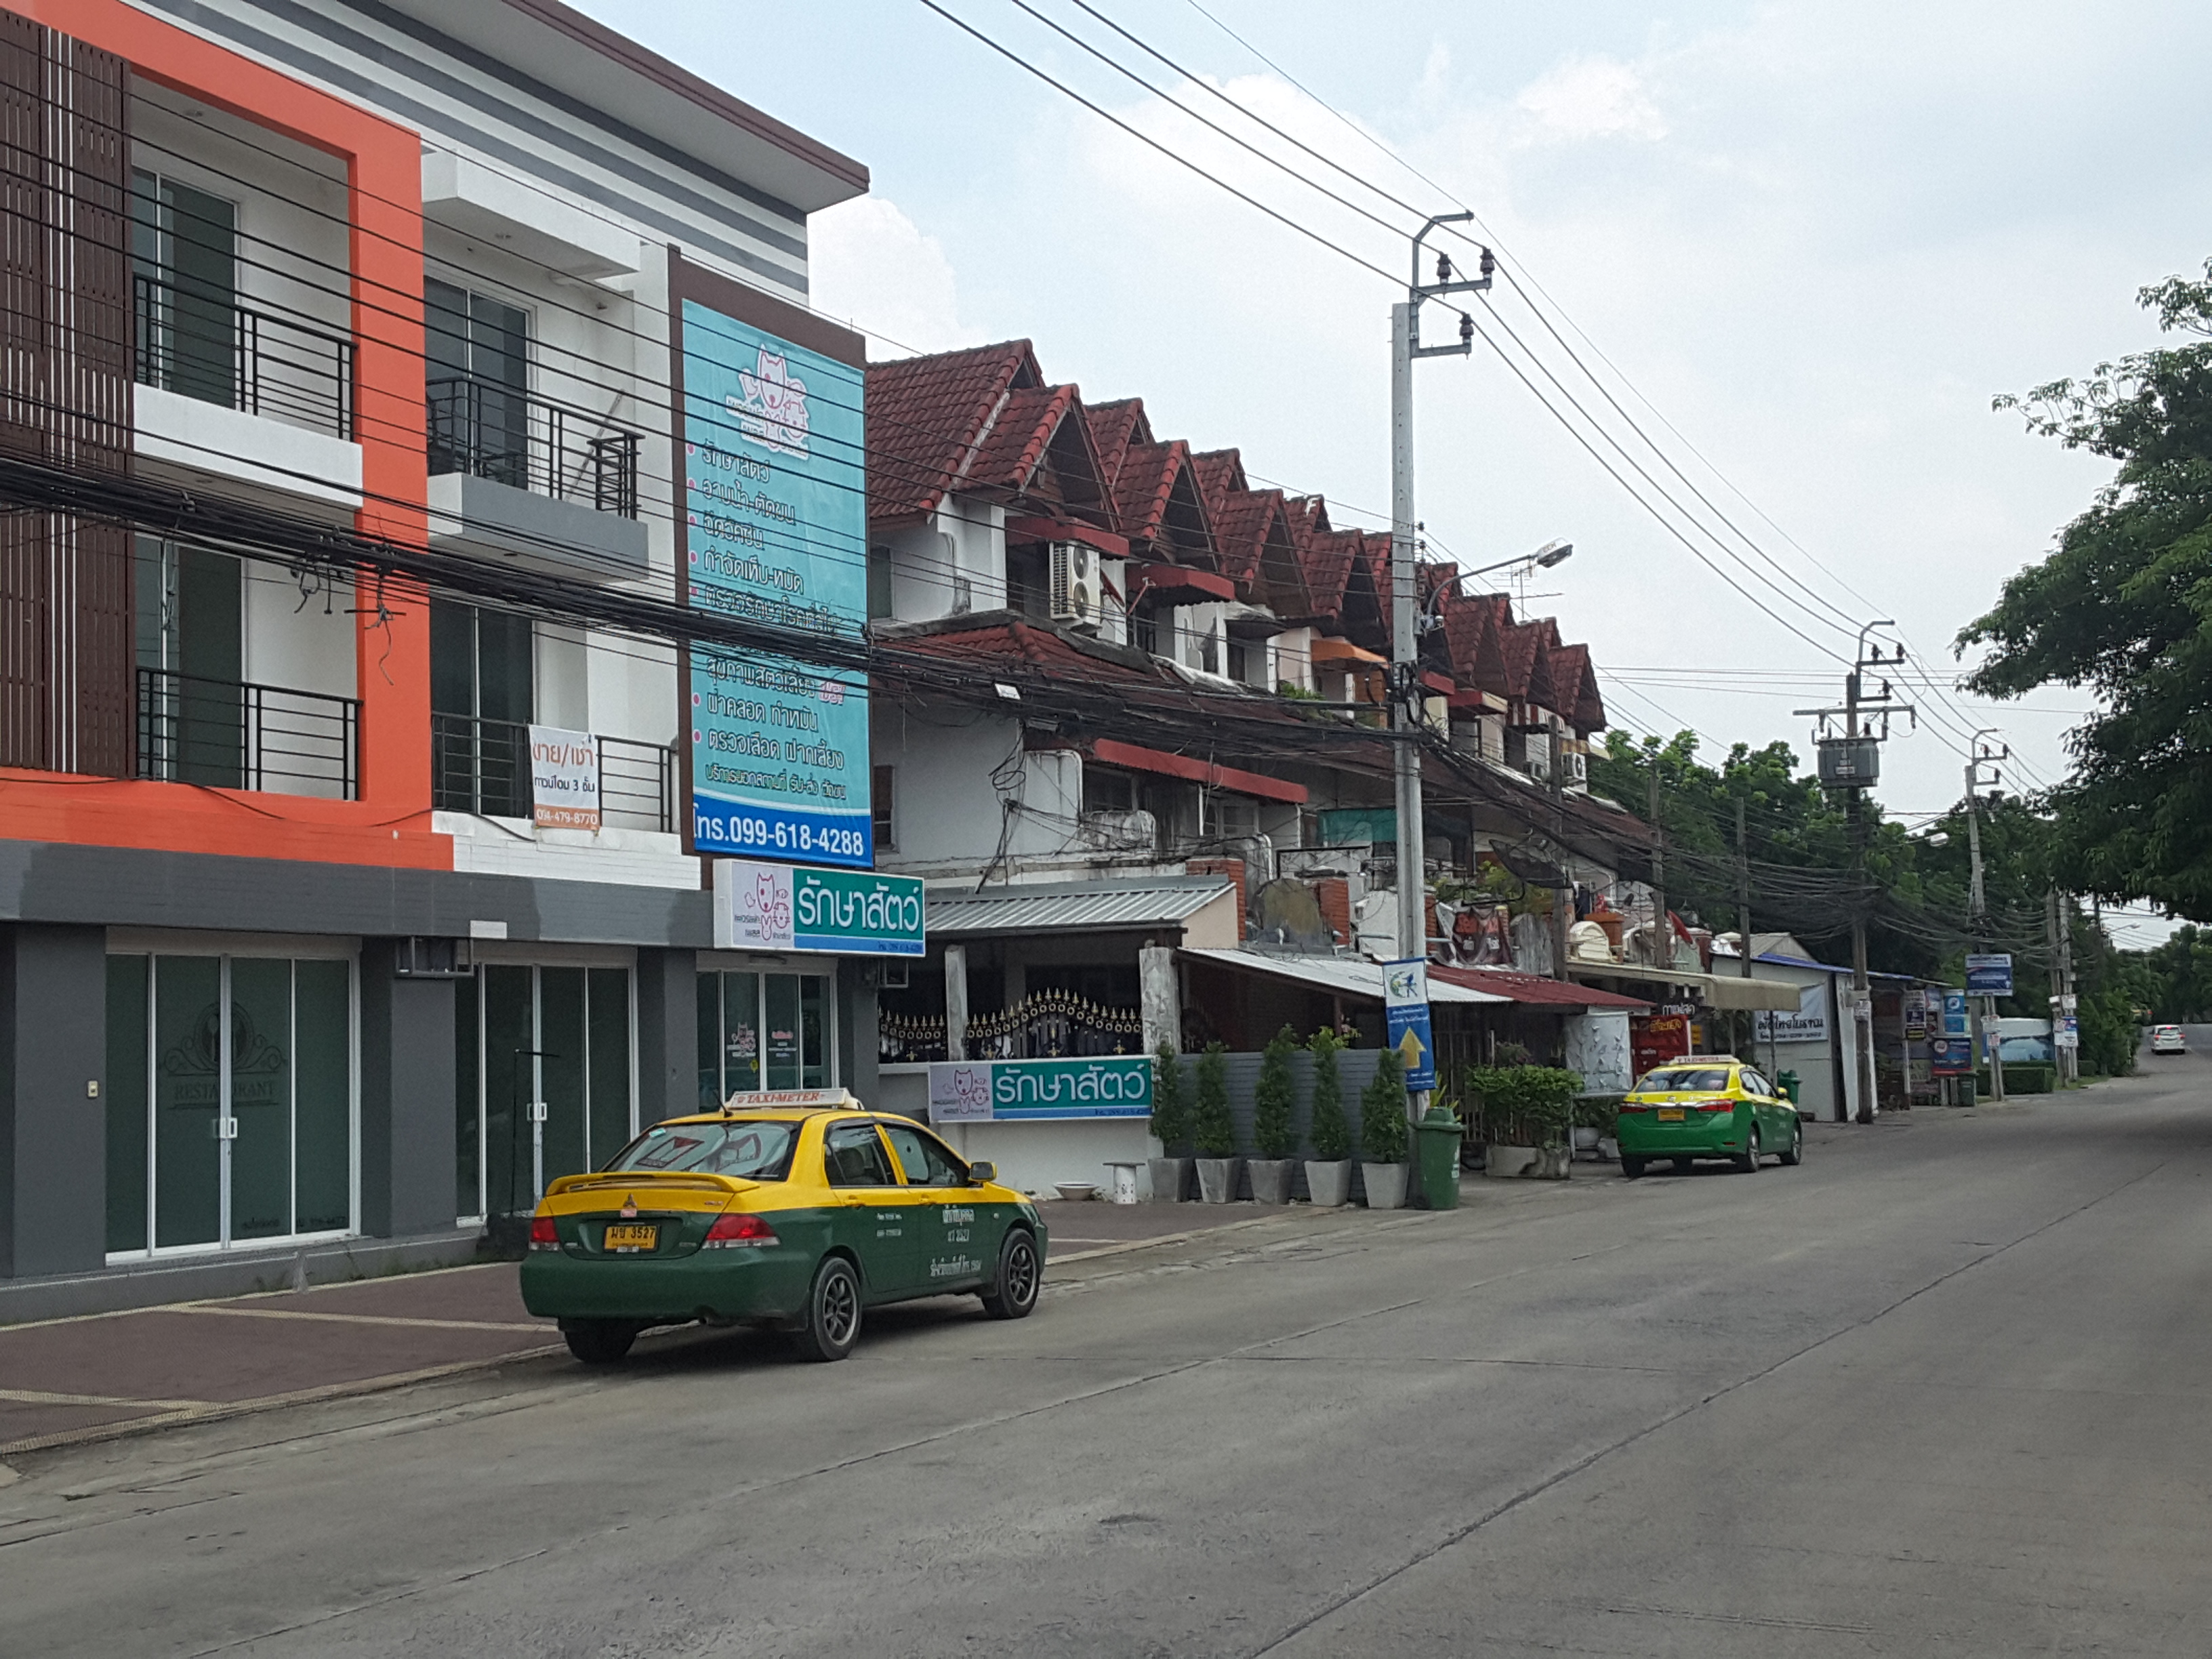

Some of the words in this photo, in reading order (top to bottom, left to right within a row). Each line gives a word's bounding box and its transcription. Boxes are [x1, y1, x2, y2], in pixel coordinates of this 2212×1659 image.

[704, 545, 804, 595] กำจัดเห็บ-หมัด
[708, 689, 766, 724] ผ่าคลอด
[771, 700, 819, 733] ทำหมัน
[708, 729, 781, 760] ตรวจเลือด
[785, 739, 844, 770] ฝากเลี้ยง
[573, 779, 579, 792] 3
[798, 875, 920, 932] รักษาสัตว์
[996, 1063, 1146, 1103] รักษาสัตว์
[630, 1225, 655, 1239] 3527
